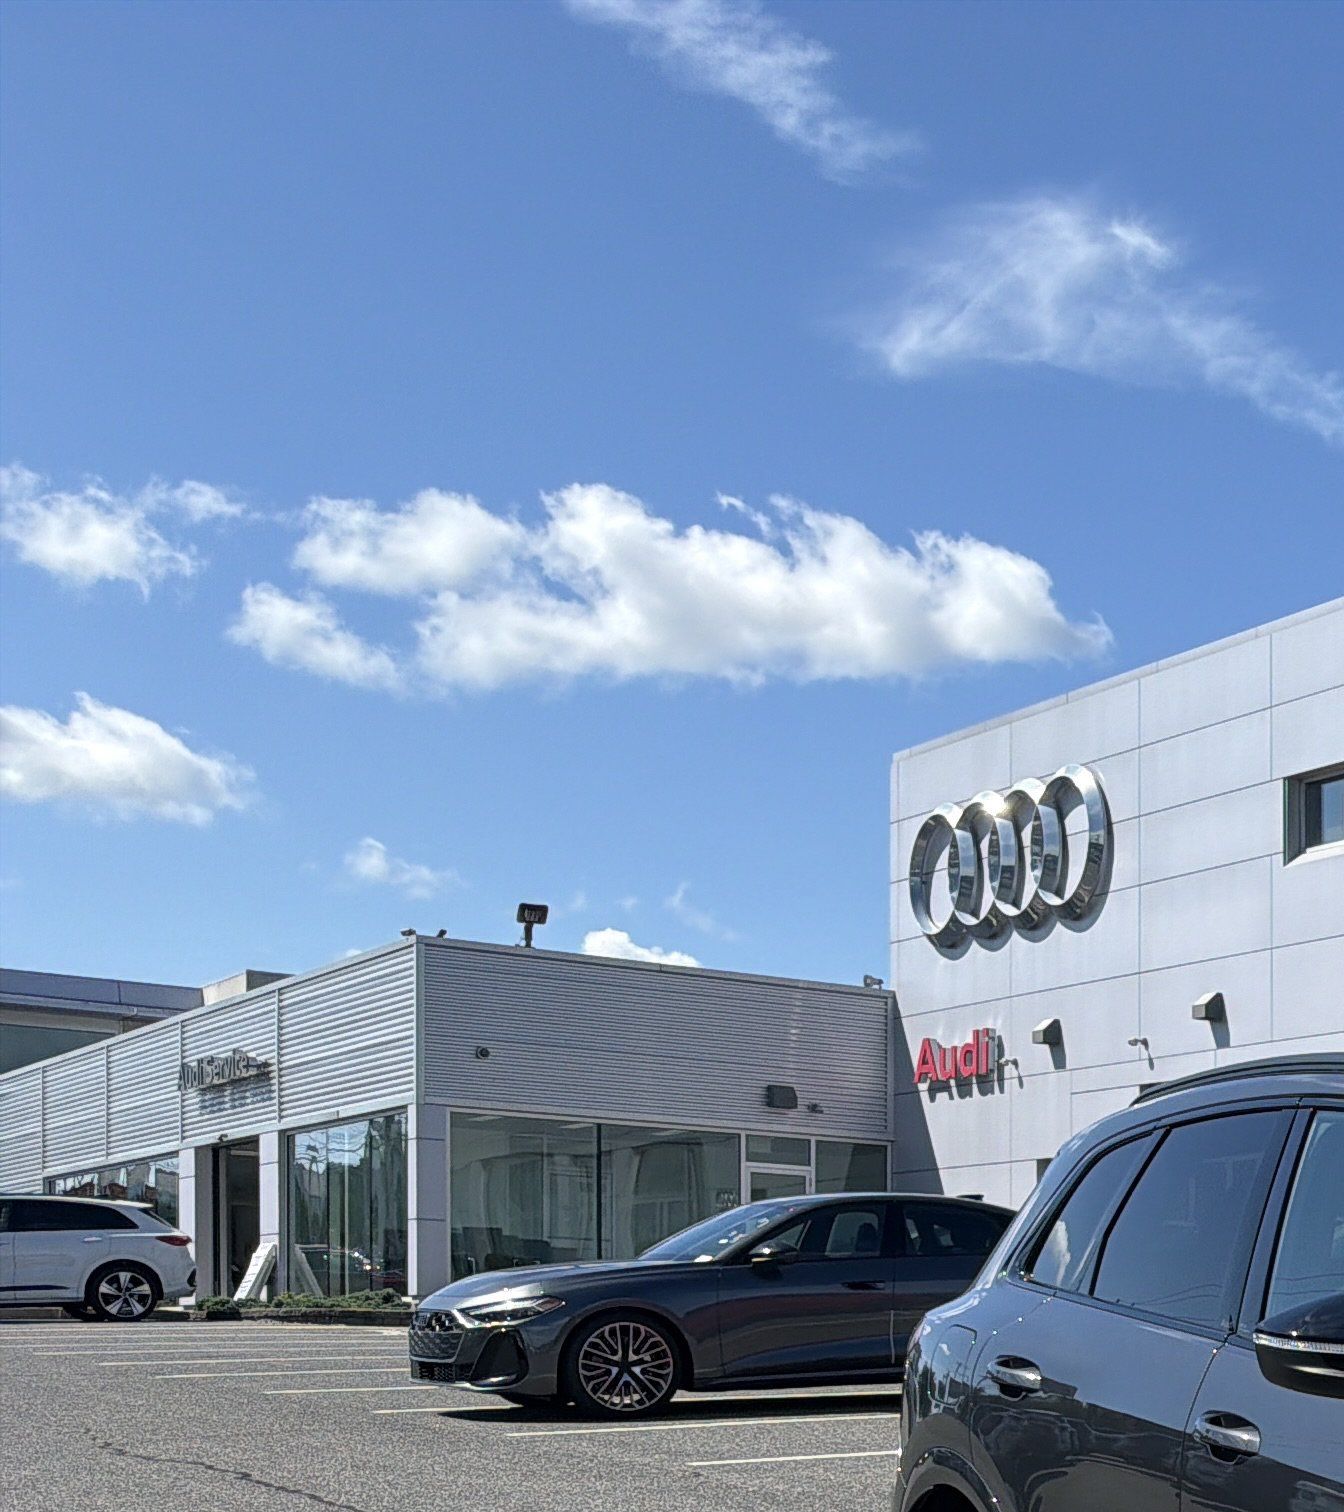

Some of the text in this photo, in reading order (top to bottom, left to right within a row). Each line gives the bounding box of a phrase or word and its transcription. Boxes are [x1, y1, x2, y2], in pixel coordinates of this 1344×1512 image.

[178, 1048, 249, 1091] Audi Service
[913, 1028, 993, 1083] Audi
